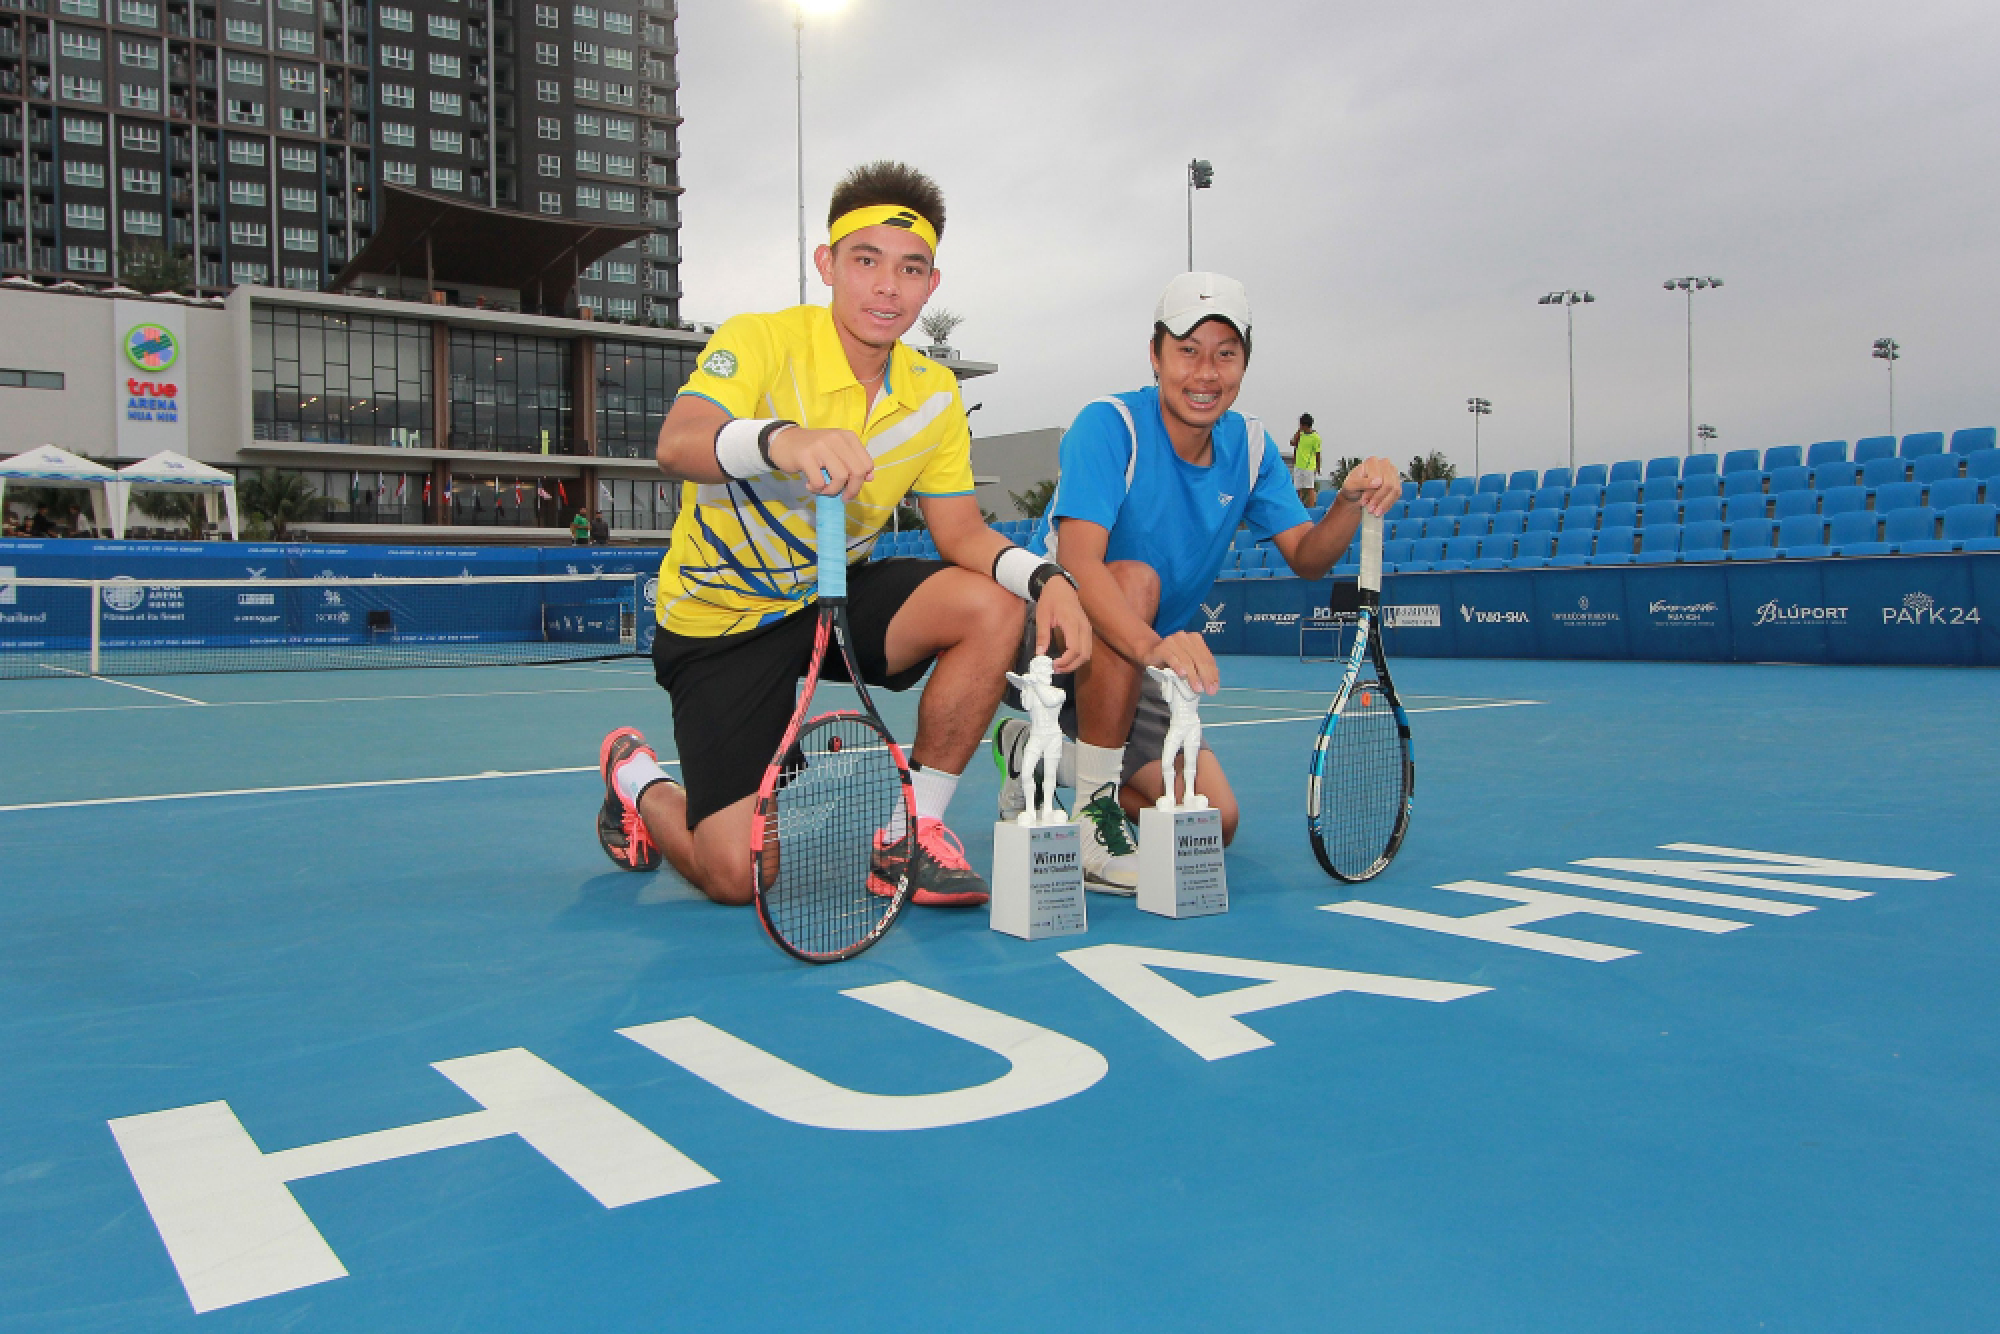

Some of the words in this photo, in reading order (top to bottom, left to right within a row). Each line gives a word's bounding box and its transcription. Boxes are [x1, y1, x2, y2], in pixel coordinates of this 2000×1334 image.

[127, 377, 178, 398] true
[128, 397, 178, 411] ARENA
[127, 411, 153, 421] HUA
[156, 411, 178, 423] HIN
[1253, 613, 1301, 621] DUNLOP
[1949, 606, 1981, 625] 24
[1177, 835, 1219, 848] Winner
[1033, 851, 1077, 866] Winner
[107, 943, 1496, 1314] HUA
